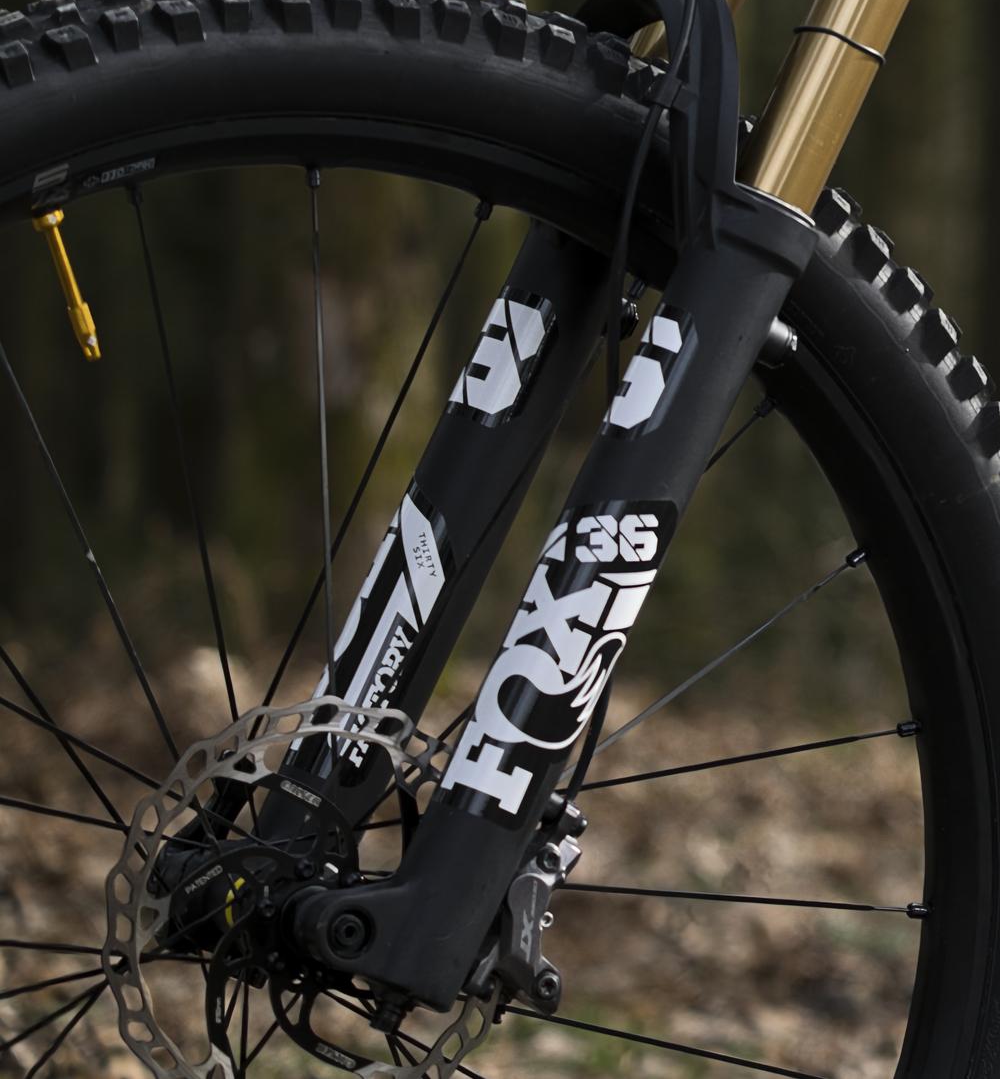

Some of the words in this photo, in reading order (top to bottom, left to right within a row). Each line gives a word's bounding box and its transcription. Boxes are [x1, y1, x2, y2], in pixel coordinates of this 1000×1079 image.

[412, 546, 425, 570] SIX
[418, 531, 438, 578] THIRTY
[575, 514, 659, 563] 36
[349, 626, 413, 769] FTORY
[441, 563, 627, 815] FOX
[184, 865, 223, 895] PATENTED
